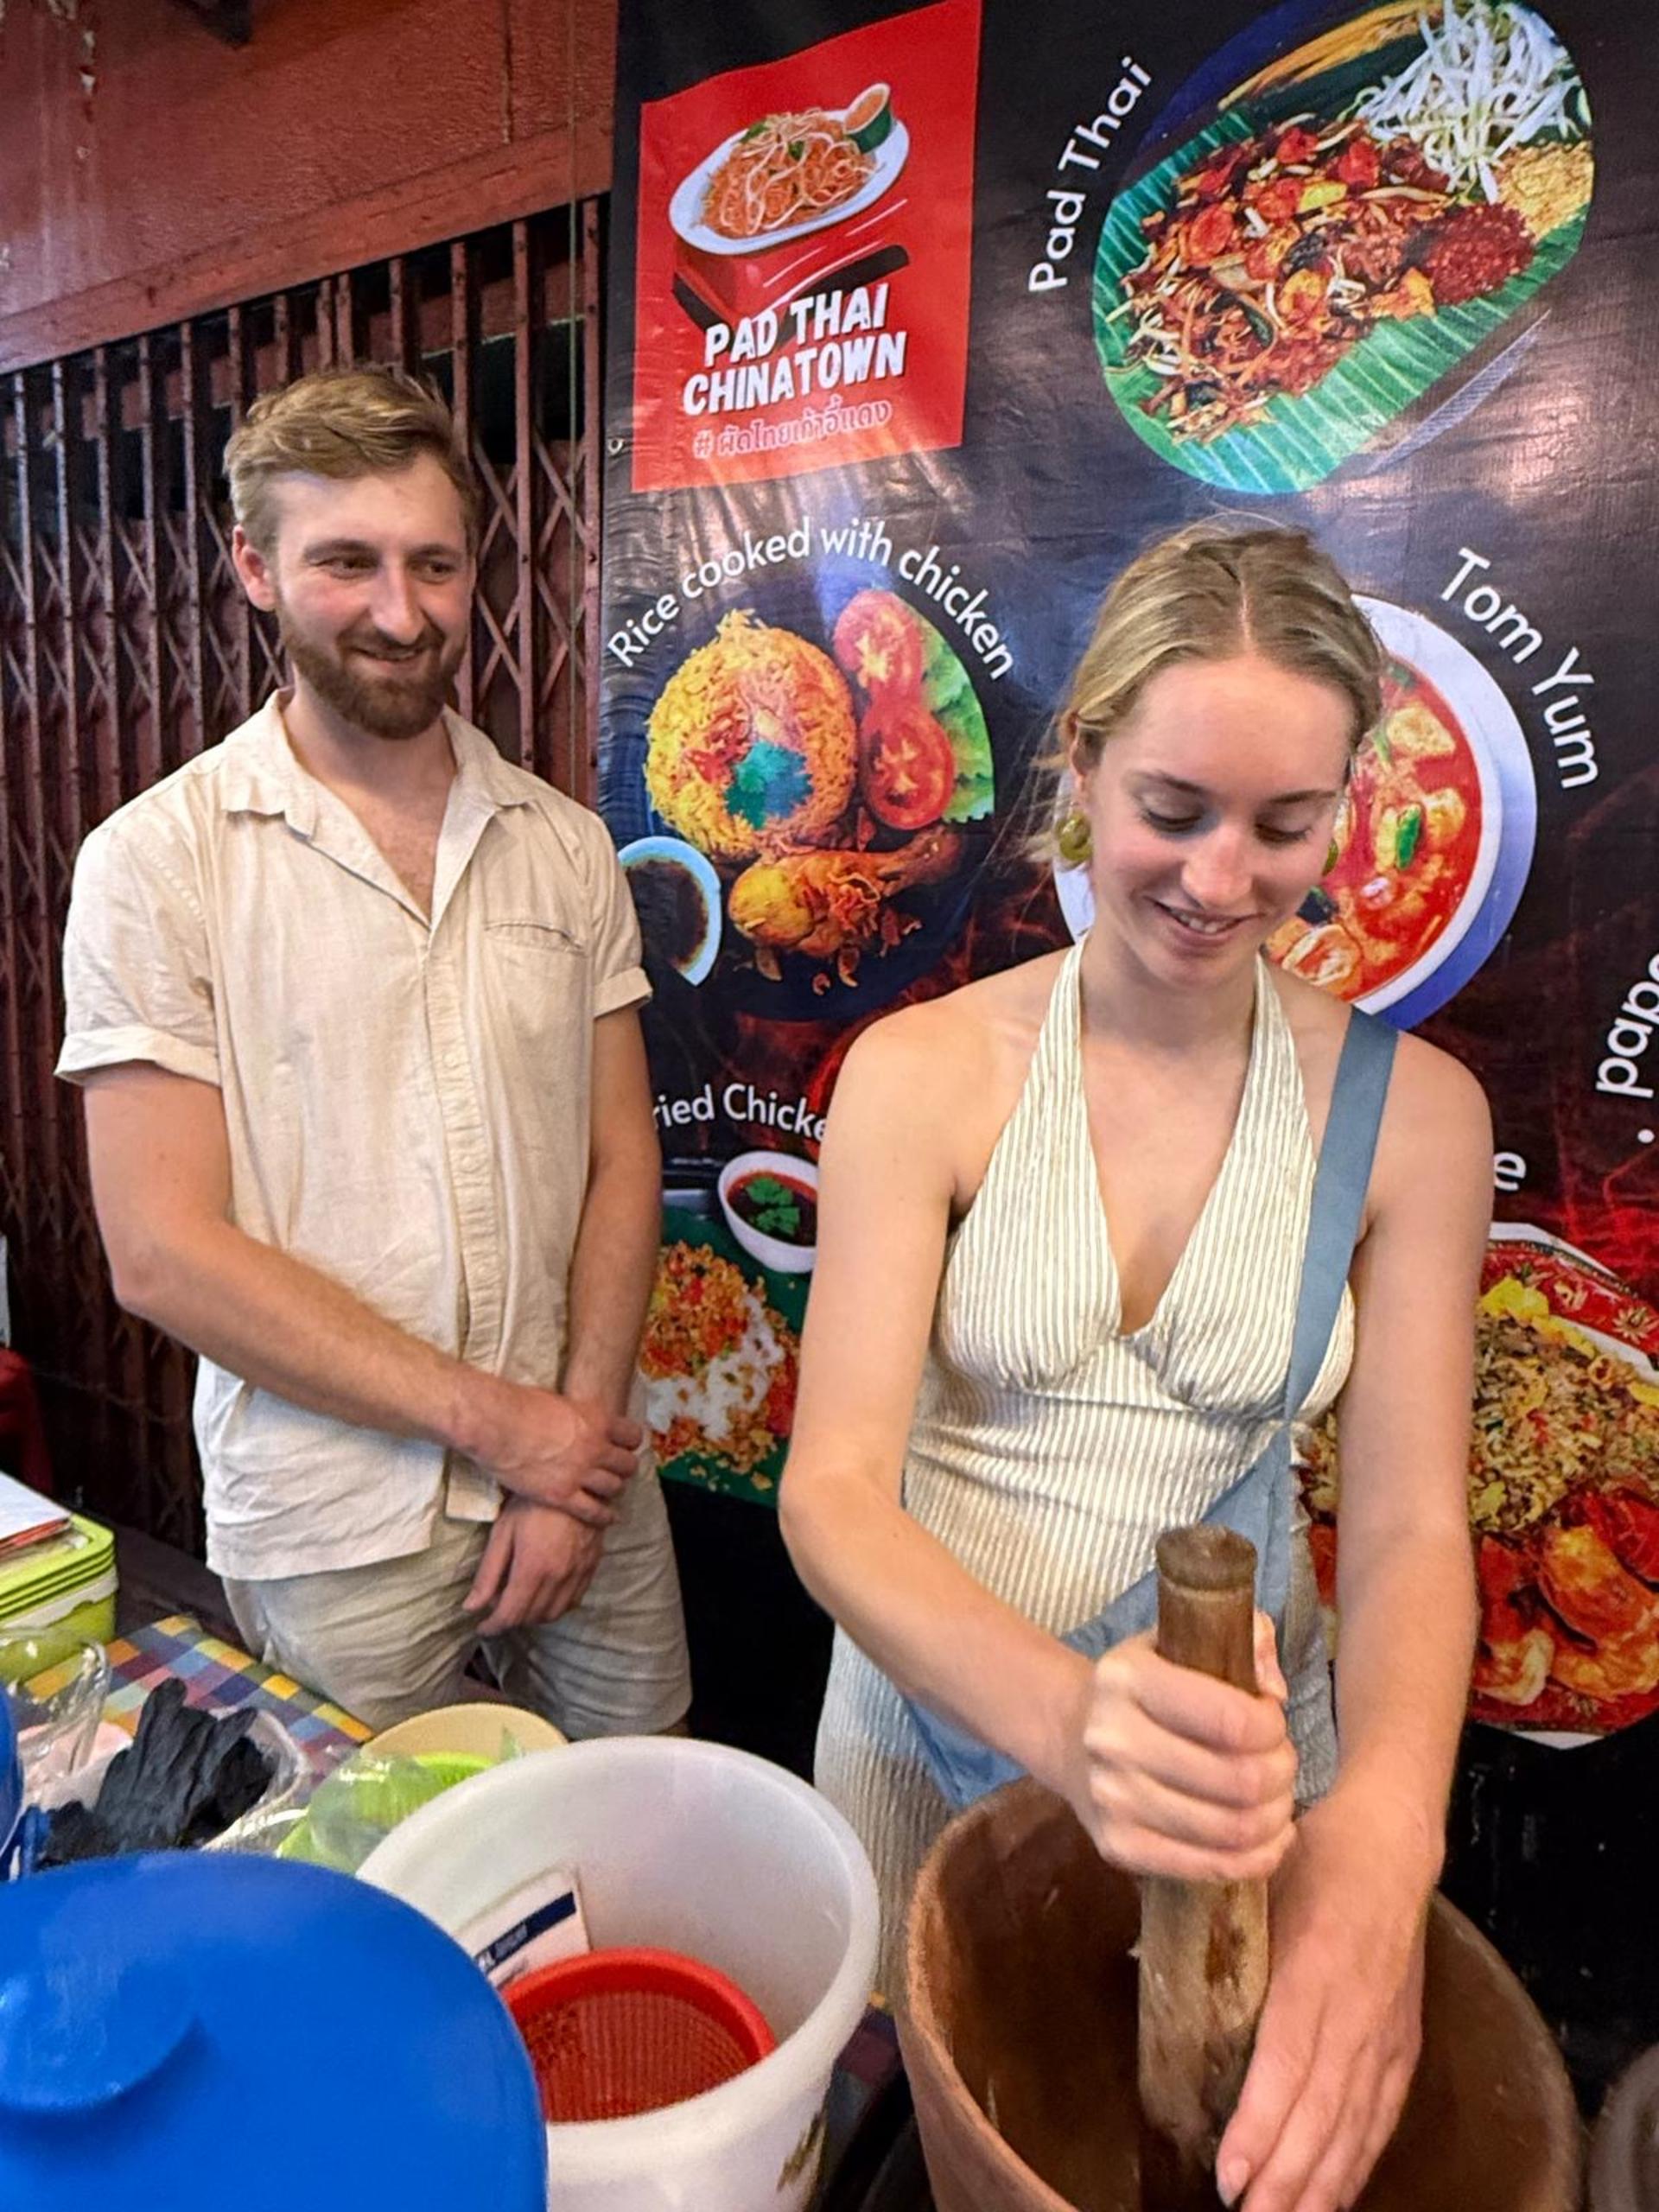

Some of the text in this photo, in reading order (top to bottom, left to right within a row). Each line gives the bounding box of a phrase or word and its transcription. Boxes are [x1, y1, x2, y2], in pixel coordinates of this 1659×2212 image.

[1027, 55, 1153, 293] Pad Thai
[682, 332, 907, 416] CHINATOWN
[704, 283, 889, 368] PAD THAI
[607, 516, 1015, 682] Rice cooked with chicken
[1440, 546, 1599, 790] Tom Yum
[652, 1082, 827, 1142] ried Chicke
